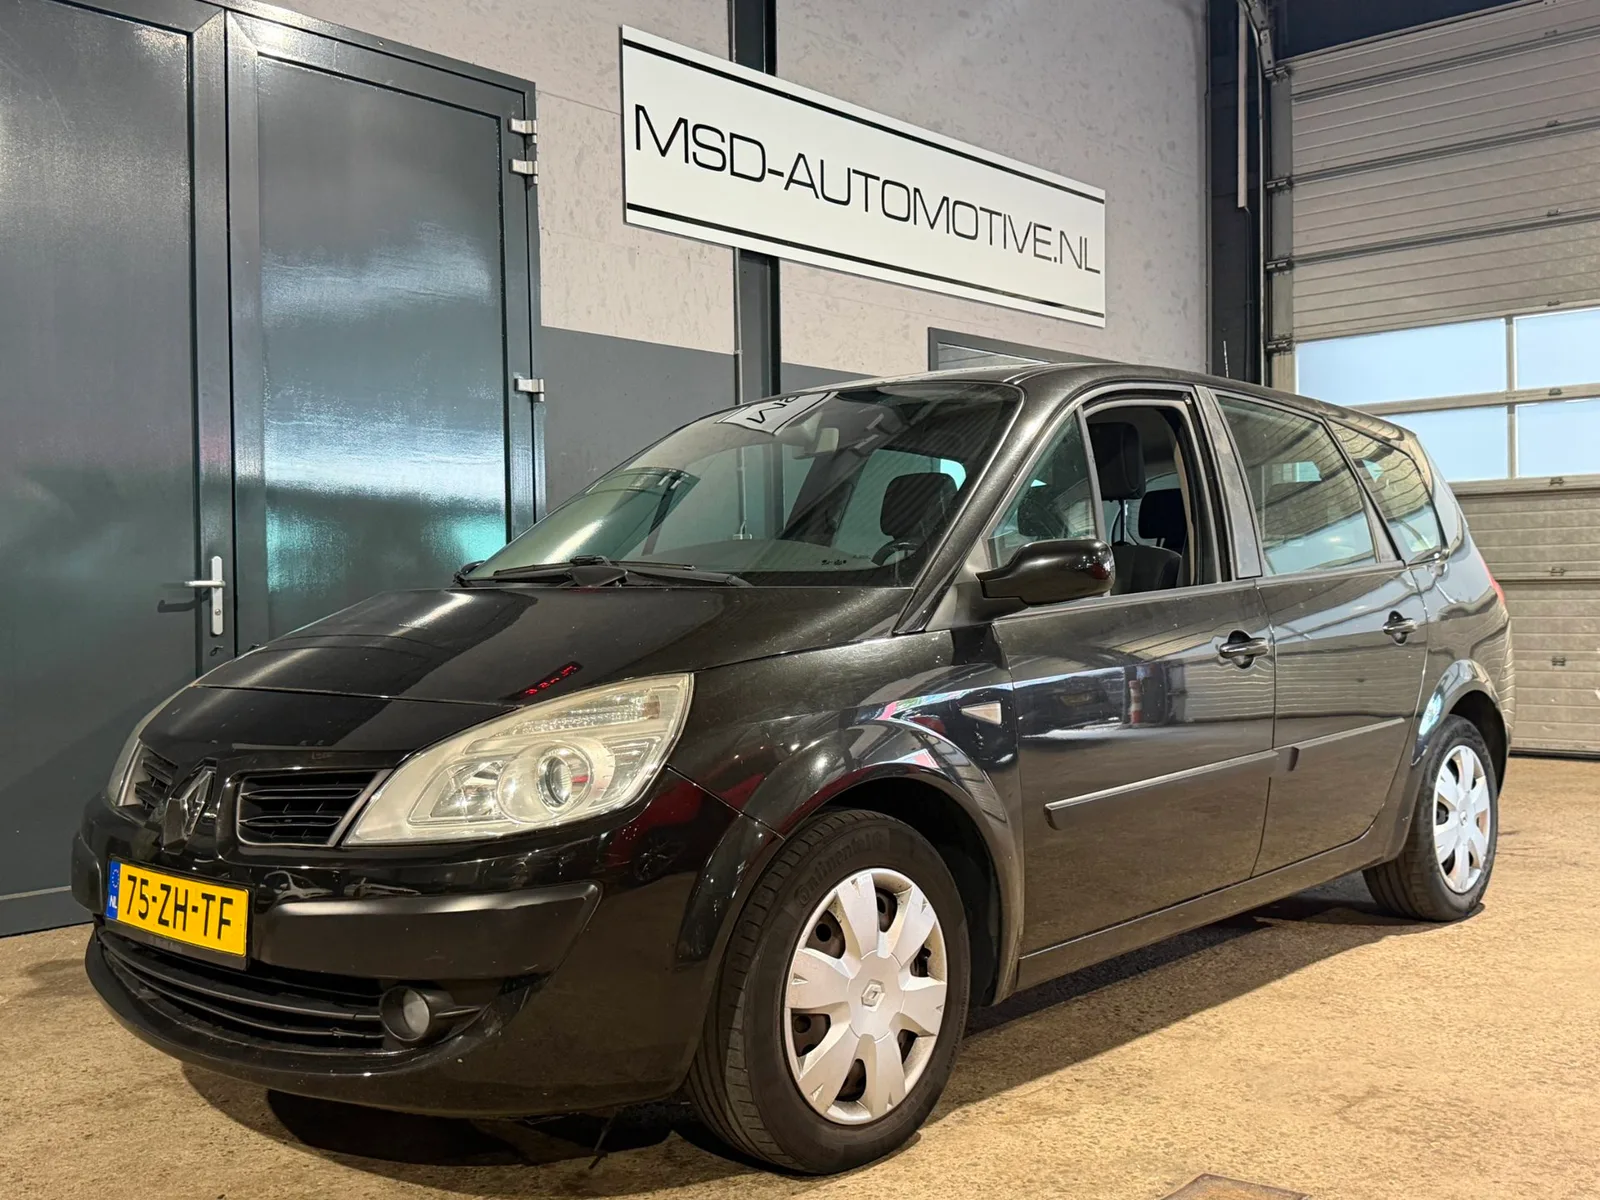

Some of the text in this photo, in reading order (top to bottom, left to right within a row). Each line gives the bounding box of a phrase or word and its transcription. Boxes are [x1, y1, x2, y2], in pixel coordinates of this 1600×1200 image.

[634, 103, 1101, 275] MSD-AUTOMOTIVE.NL
[109, 894, 118, 909] NL
[126, 874, 234, 941] 75-ZH-TF
